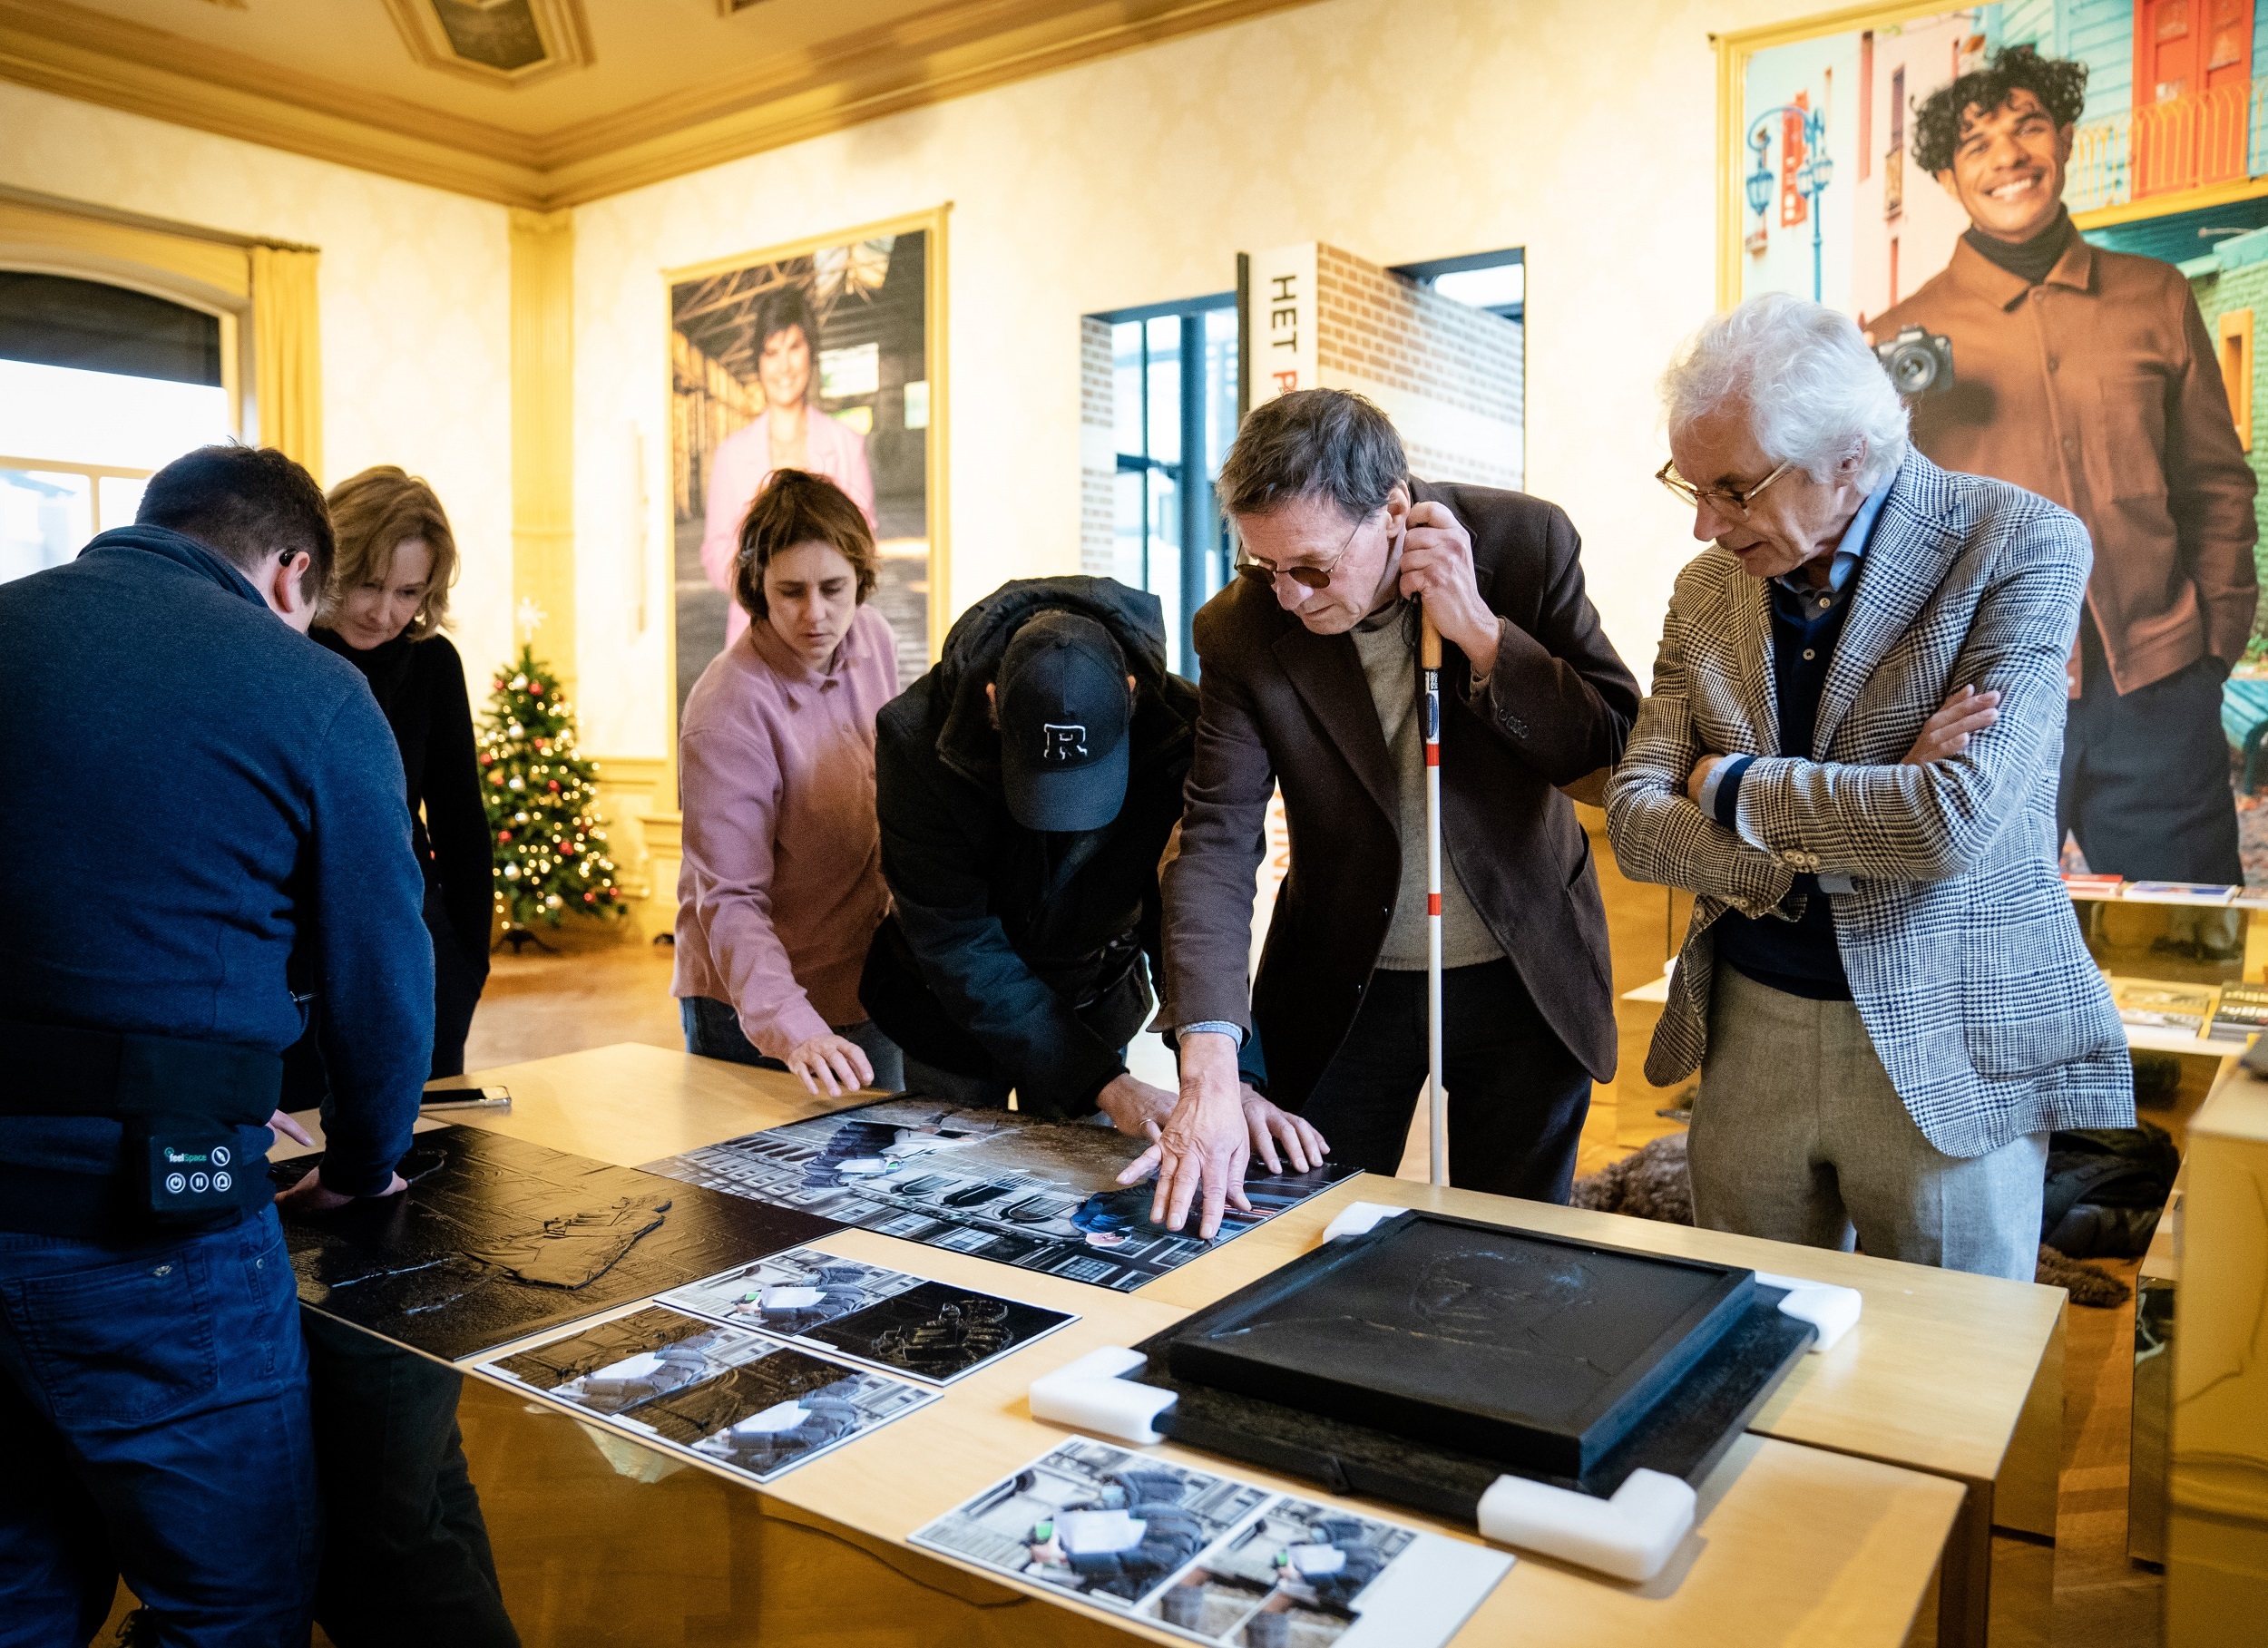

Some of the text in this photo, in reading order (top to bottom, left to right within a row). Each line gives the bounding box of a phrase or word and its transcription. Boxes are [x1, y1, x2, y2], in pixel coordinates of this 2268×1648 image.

[1271, 275, 1298, 353] HET
[1043, 723, 1088, 761] R
[169, 1153, 208, 1164] feelSpace
